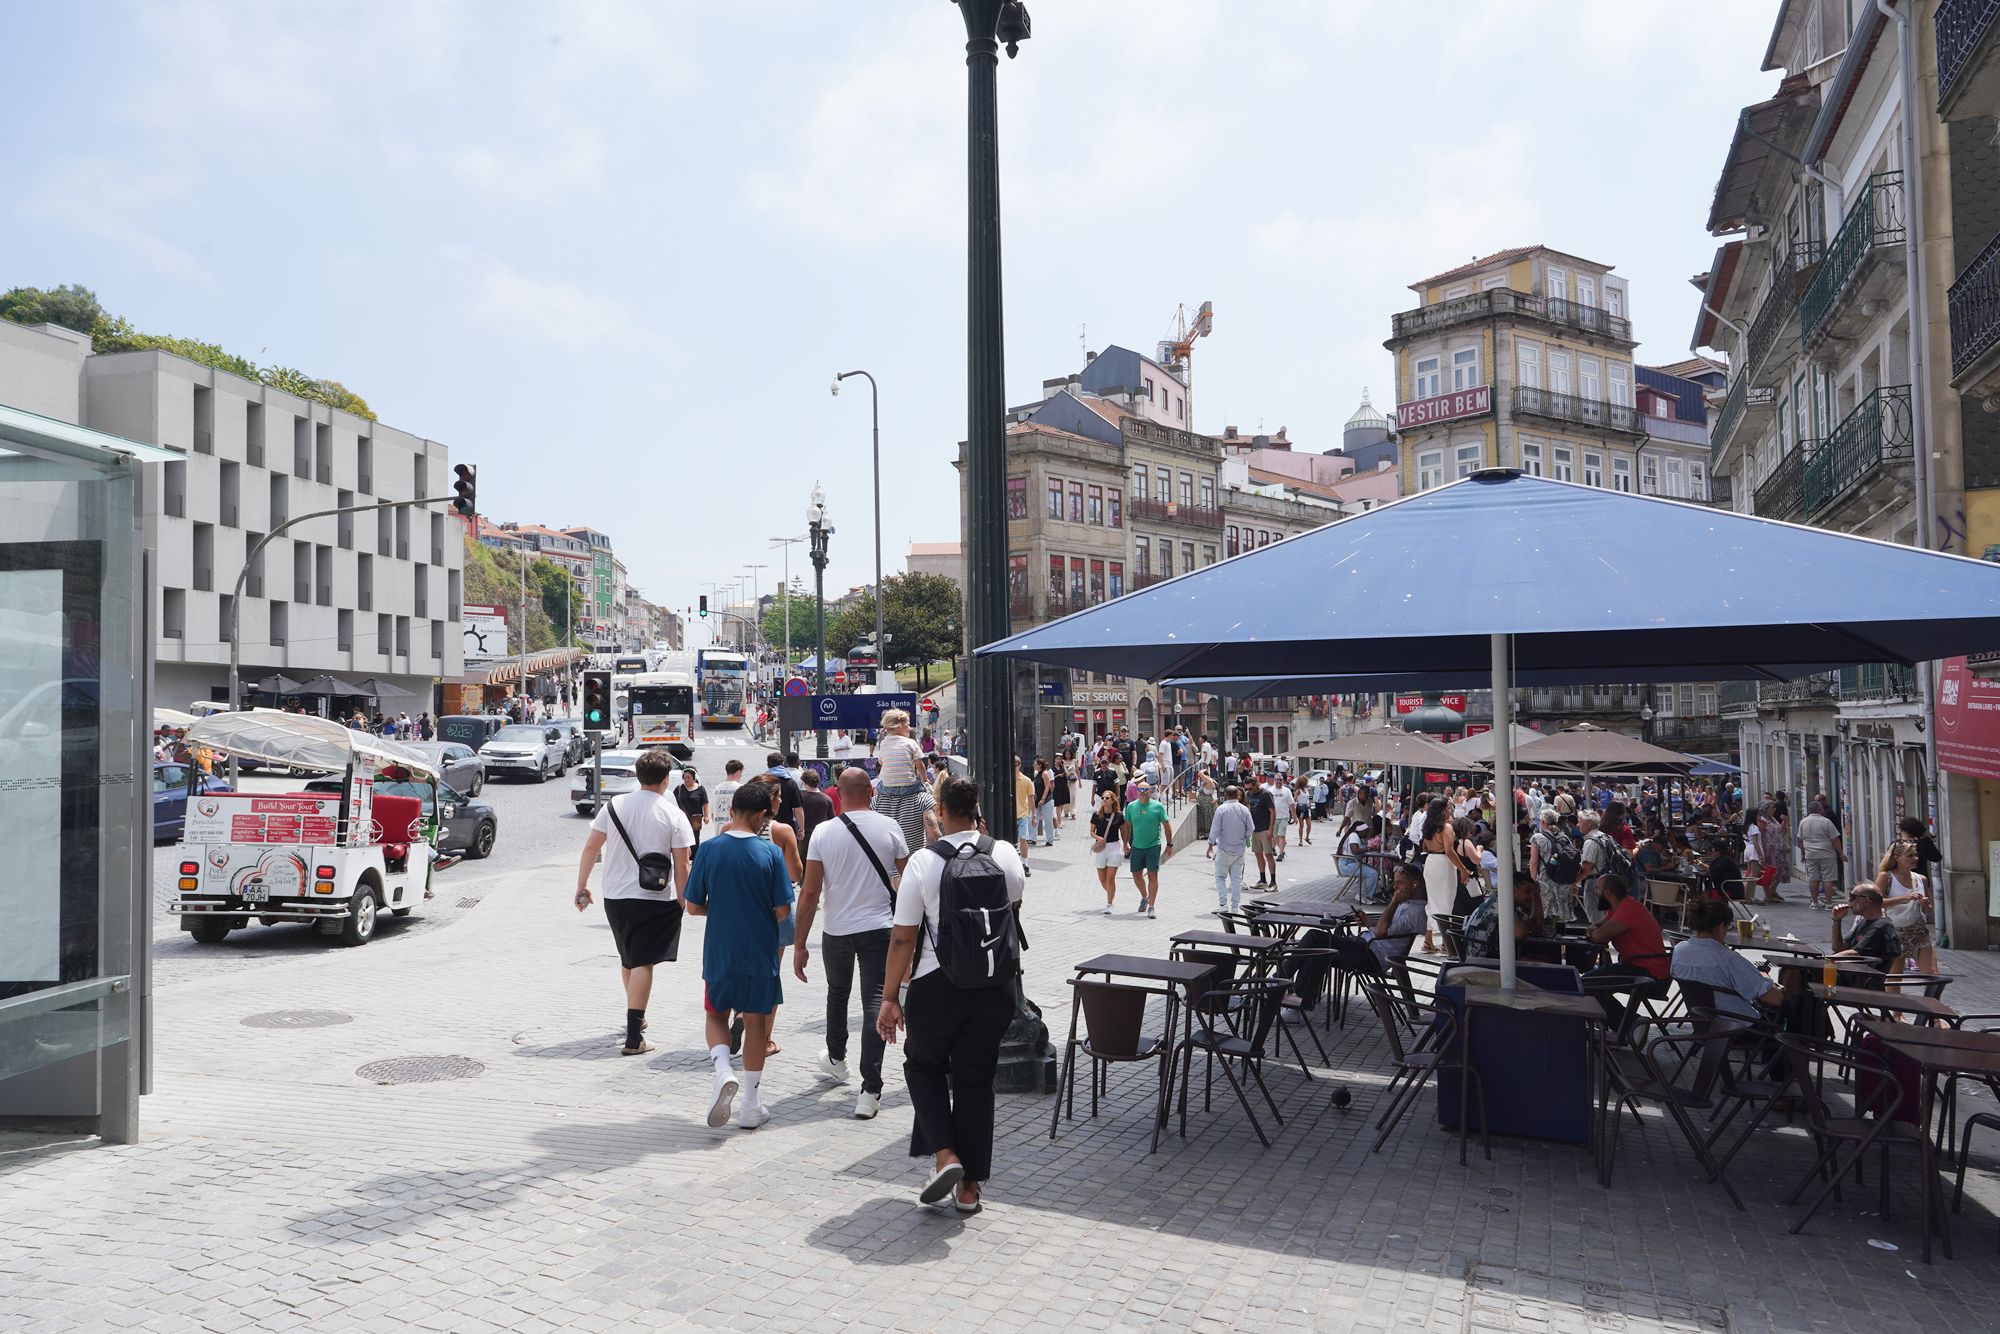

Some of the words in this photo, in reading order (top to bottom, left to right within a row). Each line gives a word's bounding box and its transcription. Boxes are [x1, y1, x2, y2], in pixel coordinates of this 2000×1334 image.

[1398, 399, 1450, 425] VESTIR
[1455, 390, 1487, 414] BEM
[1942, 680, 1960, 694] URBAN
[1072, 692, 1090, 702] RIST
[1093, 692, 1128, 702] SERVICE
[1399, 698, 1424, 706] TOURIST
[1441, 697, 1460, 705] VICE
[1941, 693, 1958, 705] MARKET
[257, 802, 277, 810] Build
[279, 802, 295, 811] Your
[298, 802, 313, 811] Tour
